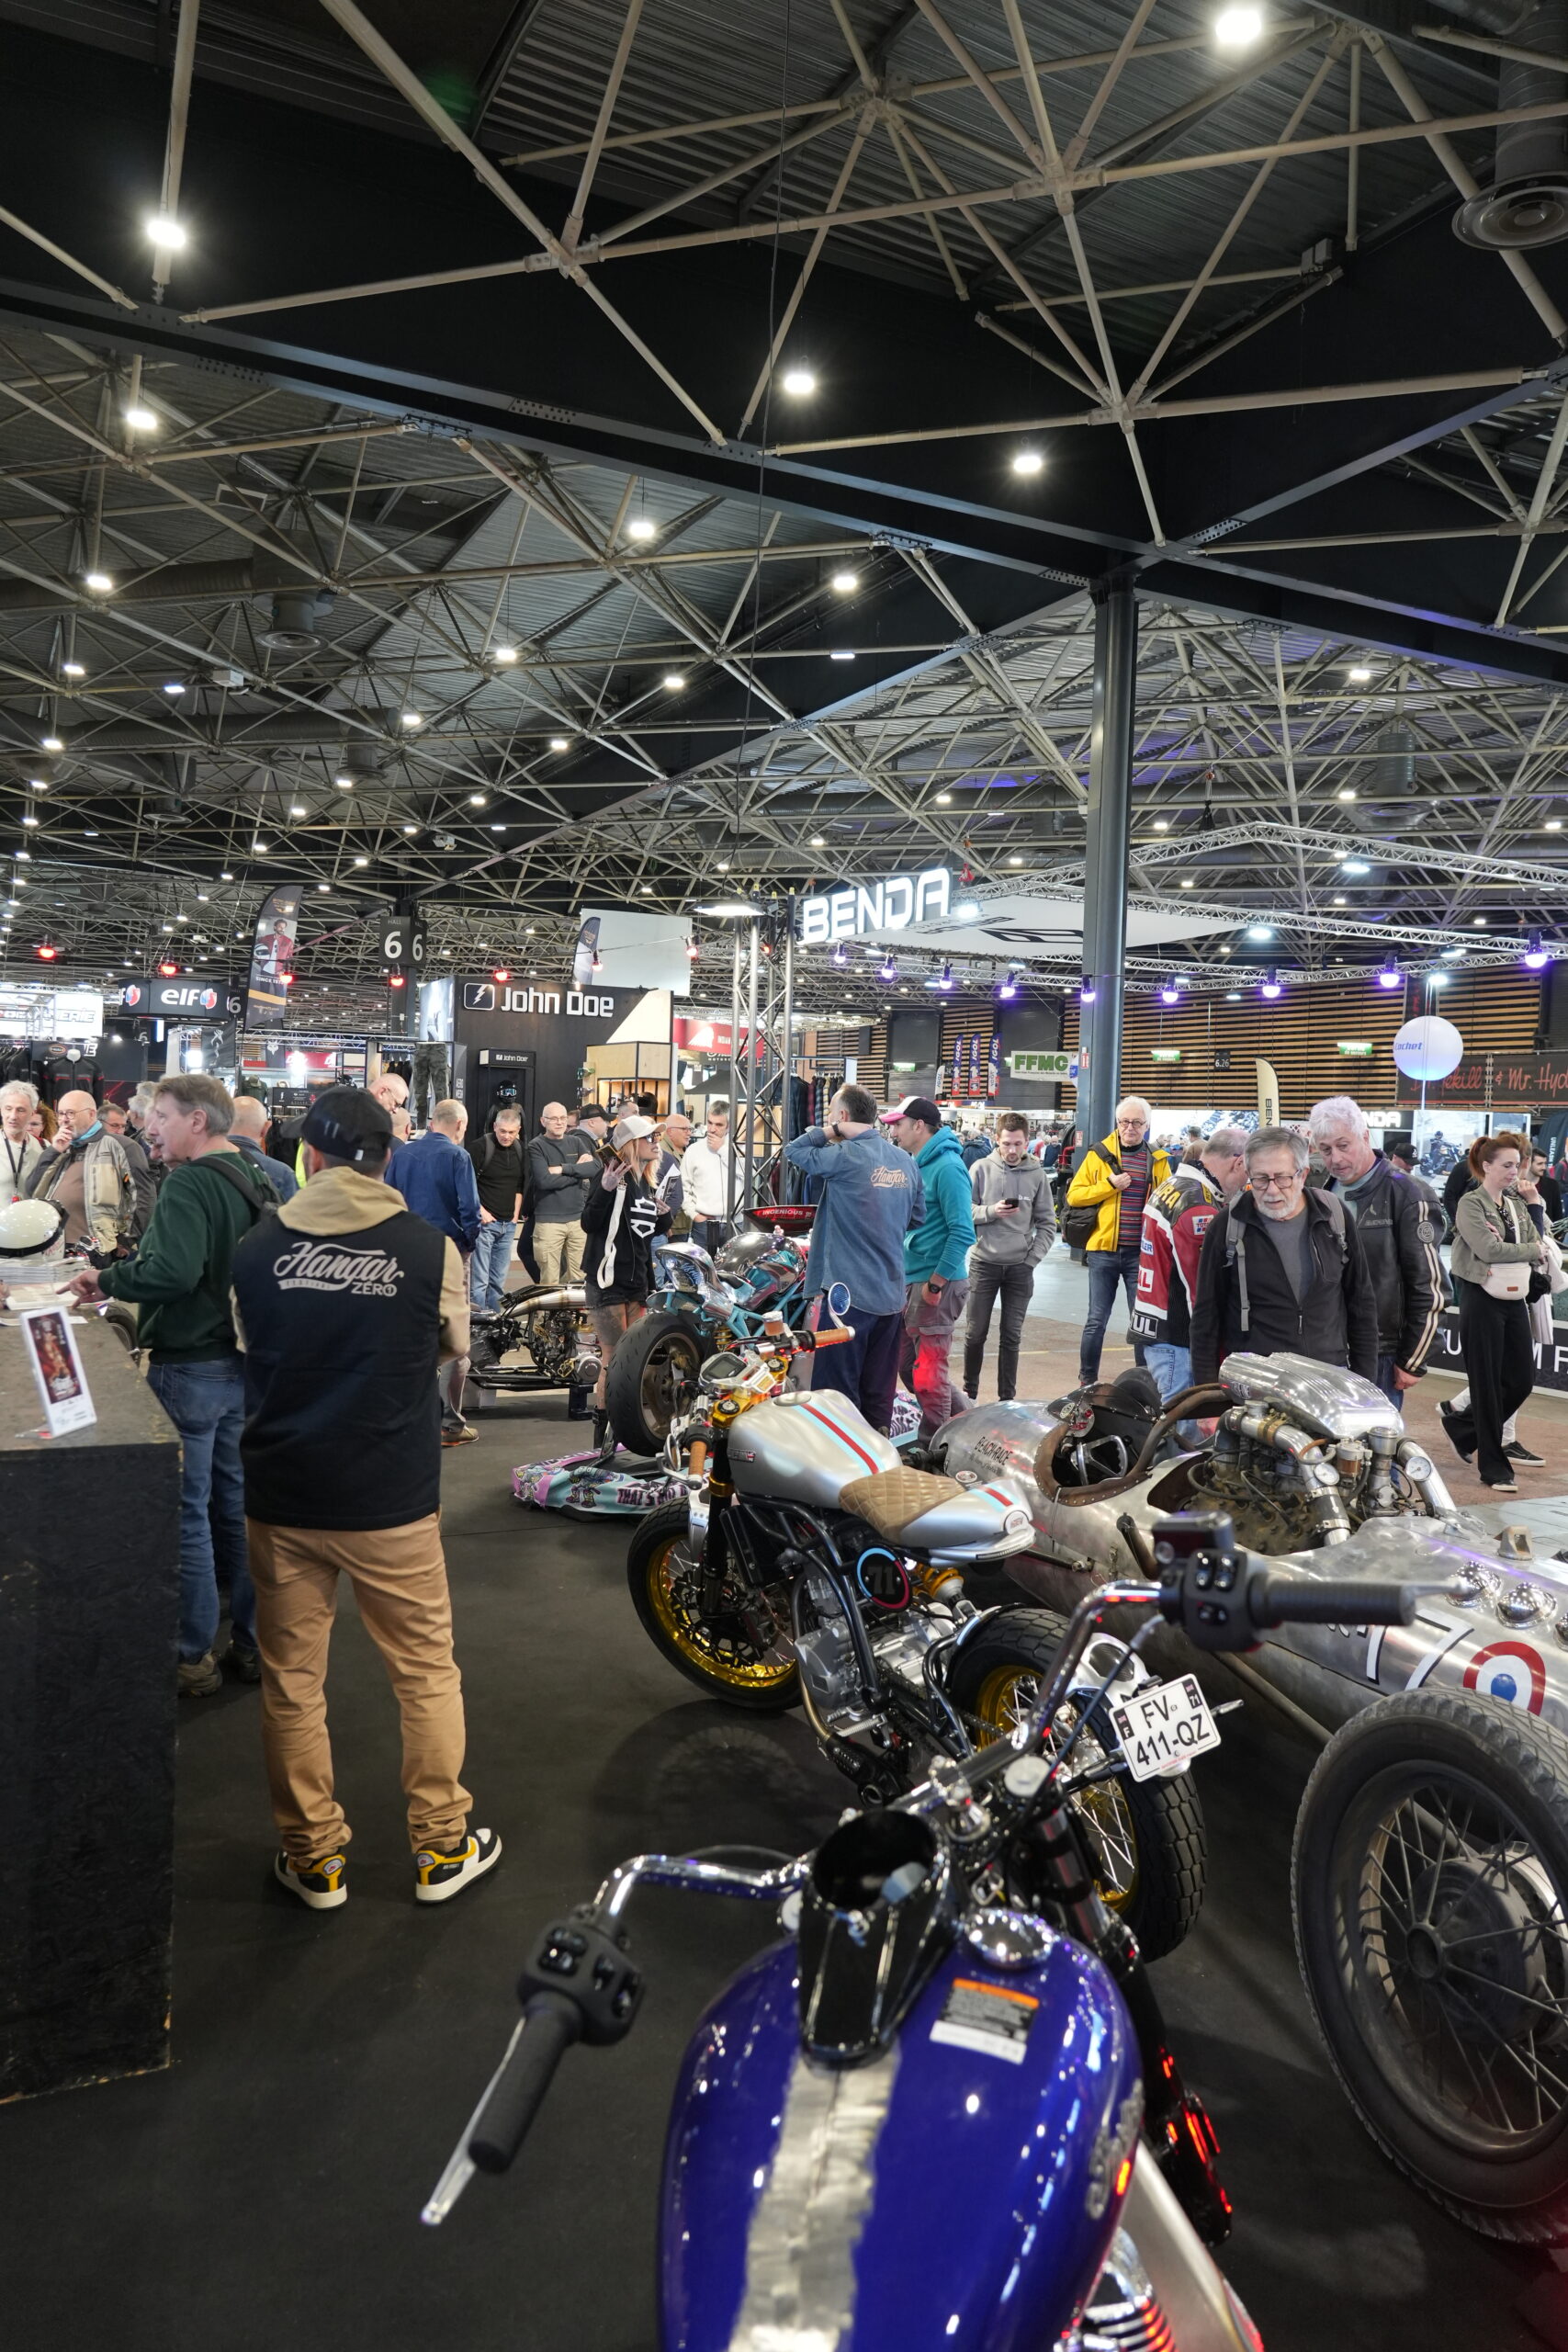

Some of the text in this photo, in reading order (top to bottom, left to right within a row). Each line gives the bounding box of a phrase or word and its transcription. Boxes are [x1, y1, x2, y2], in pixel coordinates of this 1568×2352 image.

[802, 867, 952, 945] BENDA
[384, 931, 402, 959] 6
[412, 933, 423, 961] 6
[161, 988, 199, 1006] elf
[229, 996, 242, 1014] 6
[501, 987, 615, 1018] John Doe
[1014, 1055, 1068, 1072] FFMC
[1214, 1059, 1230, 1068] 6.26
[1495, 1069, 1504, 1086] &
[1507, 1068, 1532, 1091] Mr.
[1265, 1098, 1273, 1127] BEN
[273, 1241, 405, 1283] Hangar
[1190, 1697, 1201, 1709] 71
[1122, 1726, 1132, 1738] F
[1135, 1713, 1211, 1767] 411-QZ
